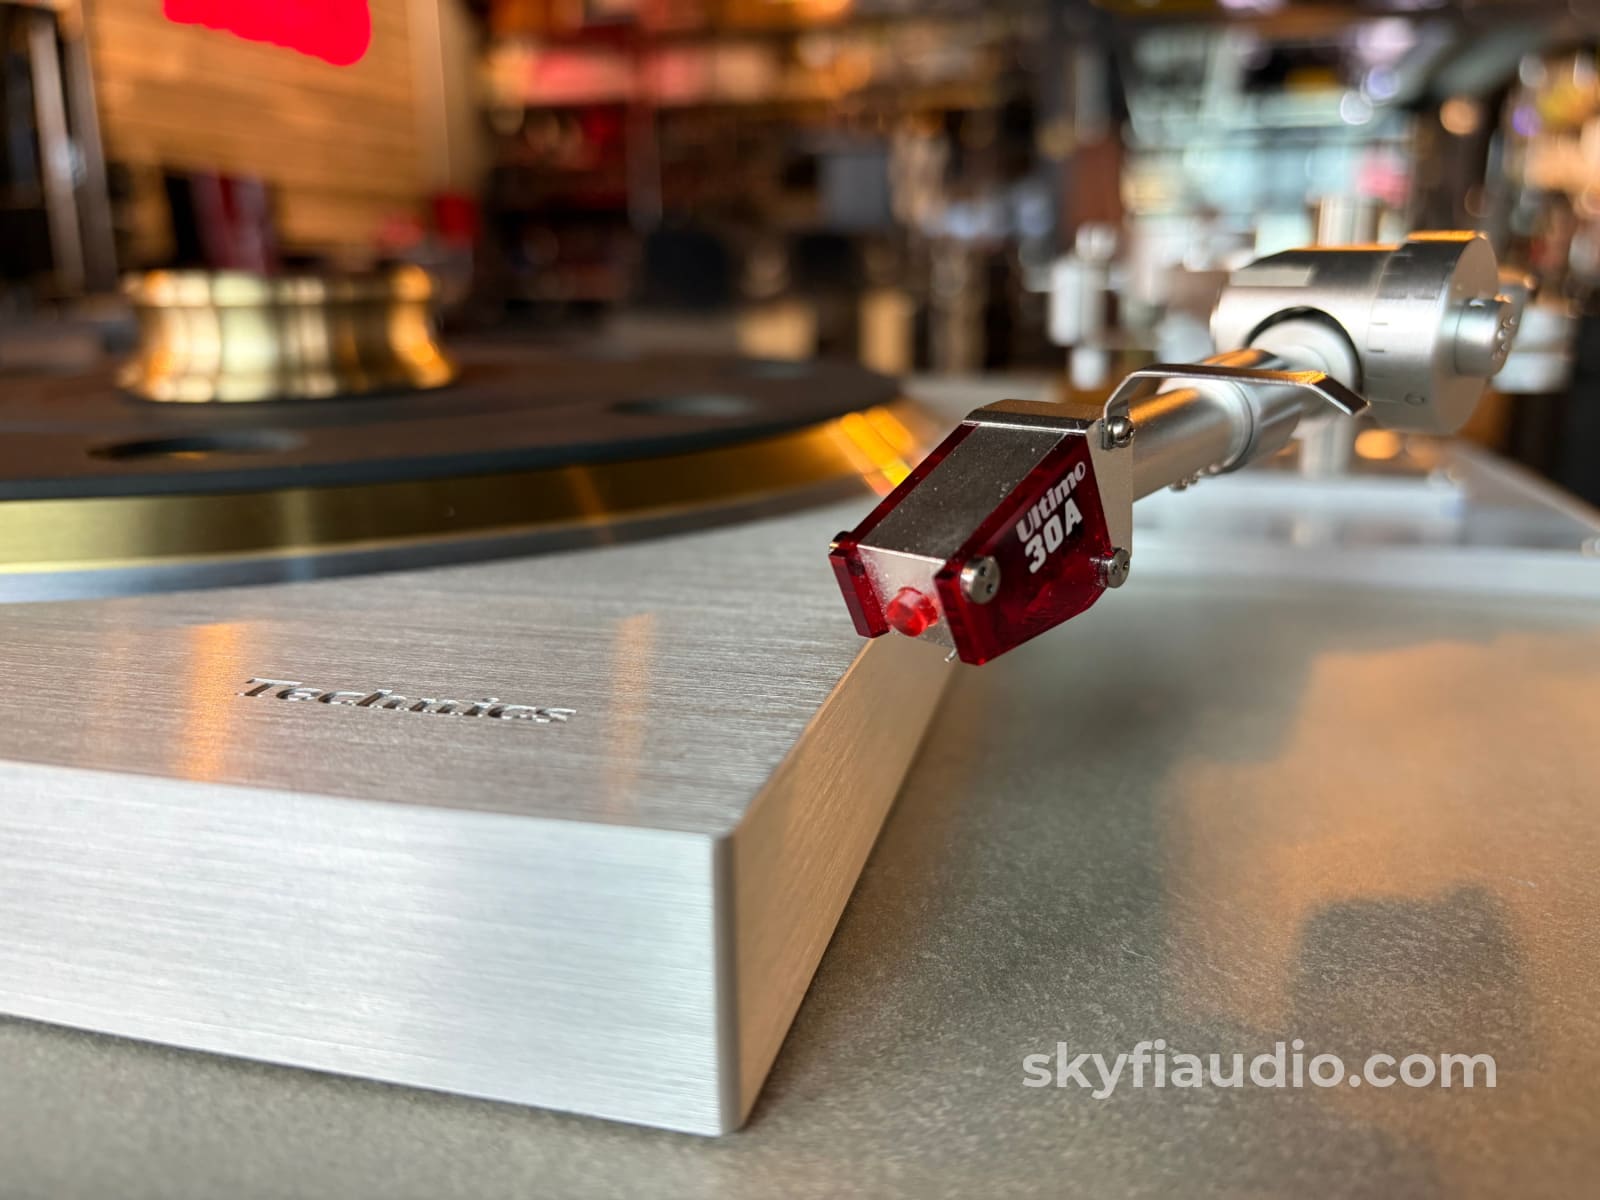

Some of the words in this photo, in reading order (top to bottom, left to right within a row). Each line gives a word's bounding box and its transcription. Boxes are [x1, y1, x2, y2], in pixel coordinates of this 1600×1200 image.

[1015, 461, 1086, 543] Ultimo
[1024, 497, 1083, 574] 30A
[235, 677, 577, 723] Technics
